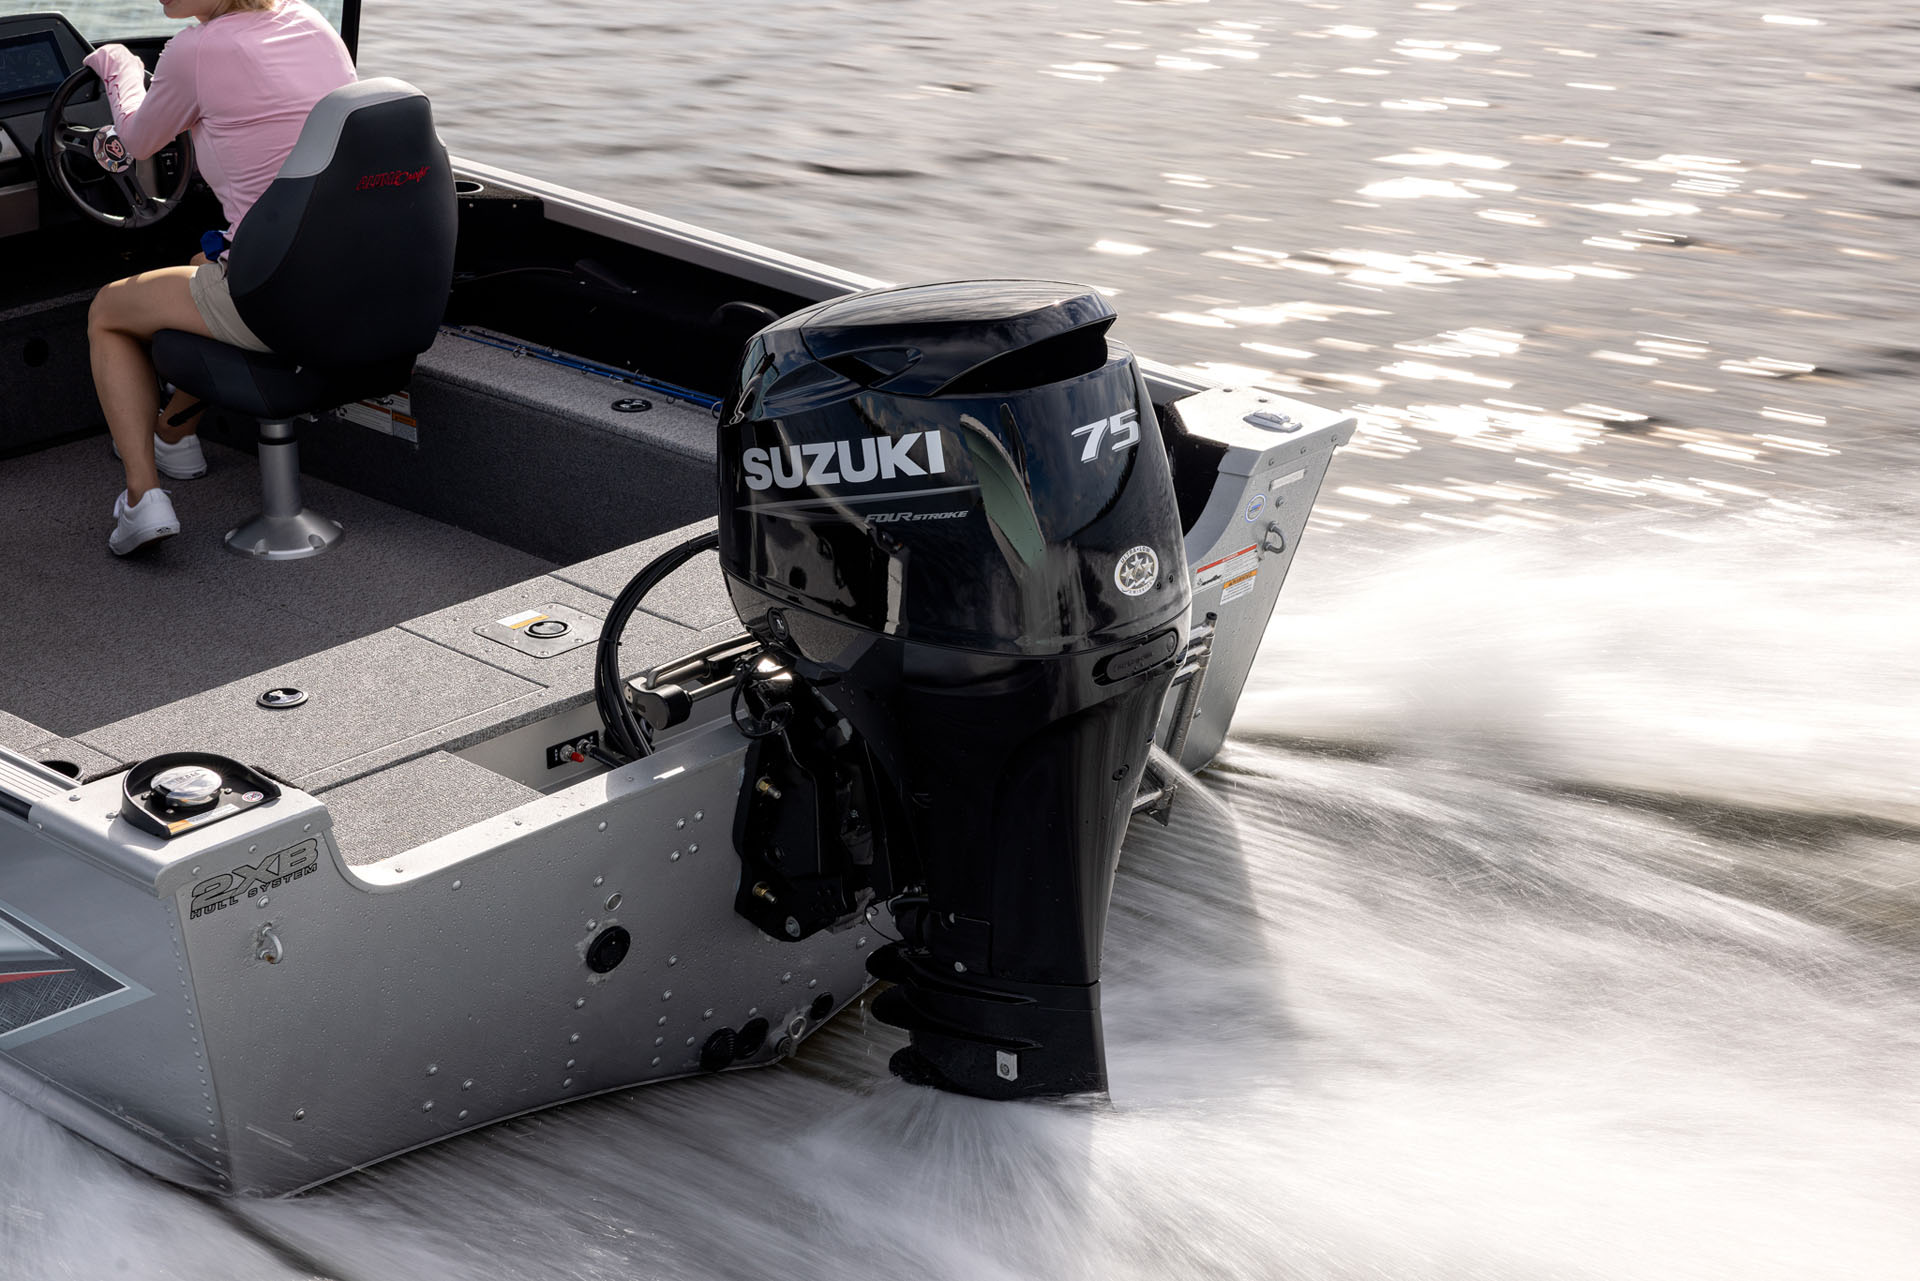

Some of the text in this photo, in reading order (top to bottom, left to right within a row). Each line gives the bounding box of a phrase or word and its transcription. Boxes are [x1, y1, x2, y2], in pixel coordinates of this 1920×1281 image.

[742, 430, 946, 491] SUZUKI
[1071, 408, 1140, 464] 75
[863, 511, 968, 524] FOUR STROKE
[190, 863, 318, 919] HULL SYSTEM
[191, 838, 319, 912] 2XB
